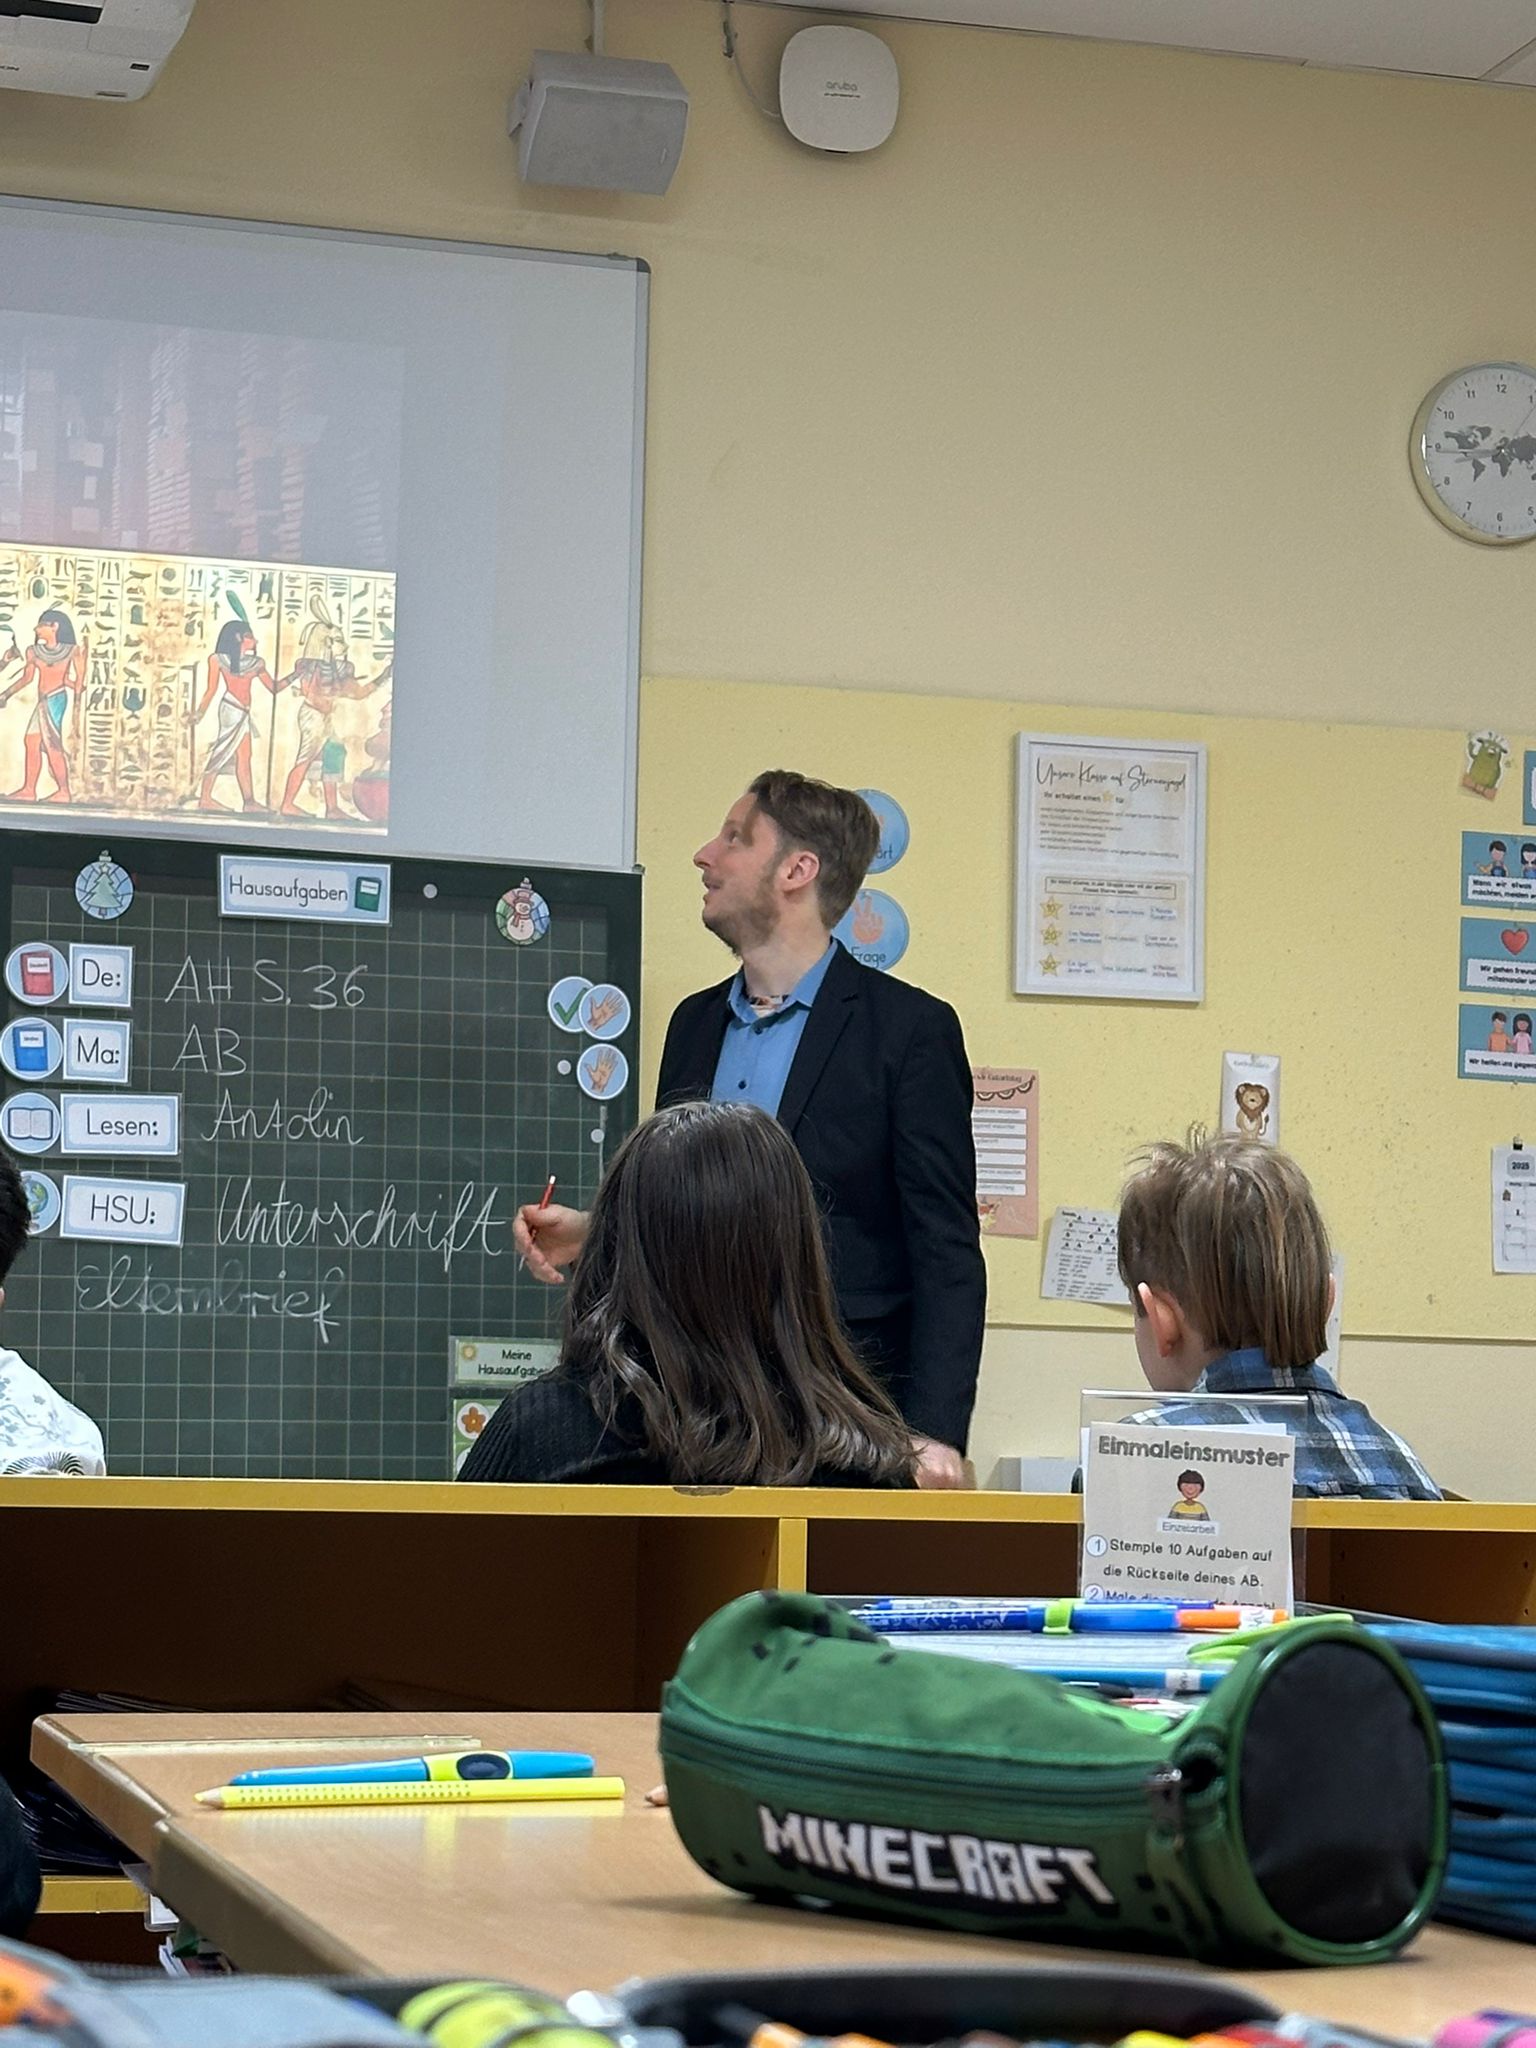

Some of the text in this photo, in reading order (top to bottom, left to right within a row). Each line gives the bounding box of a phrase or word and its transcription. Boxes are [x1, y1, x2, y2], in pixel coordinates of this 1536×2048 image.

[825, 81, 859, 91] aruba
[1467, 390, 1476, 399] 11
[1496, 384, 1507, 394] 12
[1444, 410, 1455, 420] 10
[229, 874, 349, 907] Hausaufgaben
[851, 946, 887, 968] Frage
[81, 959, 122, 988] De:
[165, 955, 236, 1004] AH
[301, 964, 371, 1011] 36
[77, 1035, 120, 1065] Ma:
[171, 1023, 248, 1076] AB
[86, 1107, 159, 1136] Lesen:
[200, 1086, 365, 1145] Antolin
[90, 1193, 156, 1226] HSU:
[216, 1175, 507, 1273] Unterschrift
[75, 1255, 345, 1344] Elternbrief
[501, 1349, 532, 1361] Meine
[1098, 1435, 1291, 1468] Einmaleinsmuster
[1162, 1521, 1217, 1535] Einzelarbeit
[1094, 1538, 1273, 1562] 1 Stemple 10 Aufgaben auf
[1103, 1564, 1264, 1588] die Rückseite deines AB.
[1089, 1586, 1099, 1601] 2
[757, 1803, 1116, 1905] MINECRAFT
